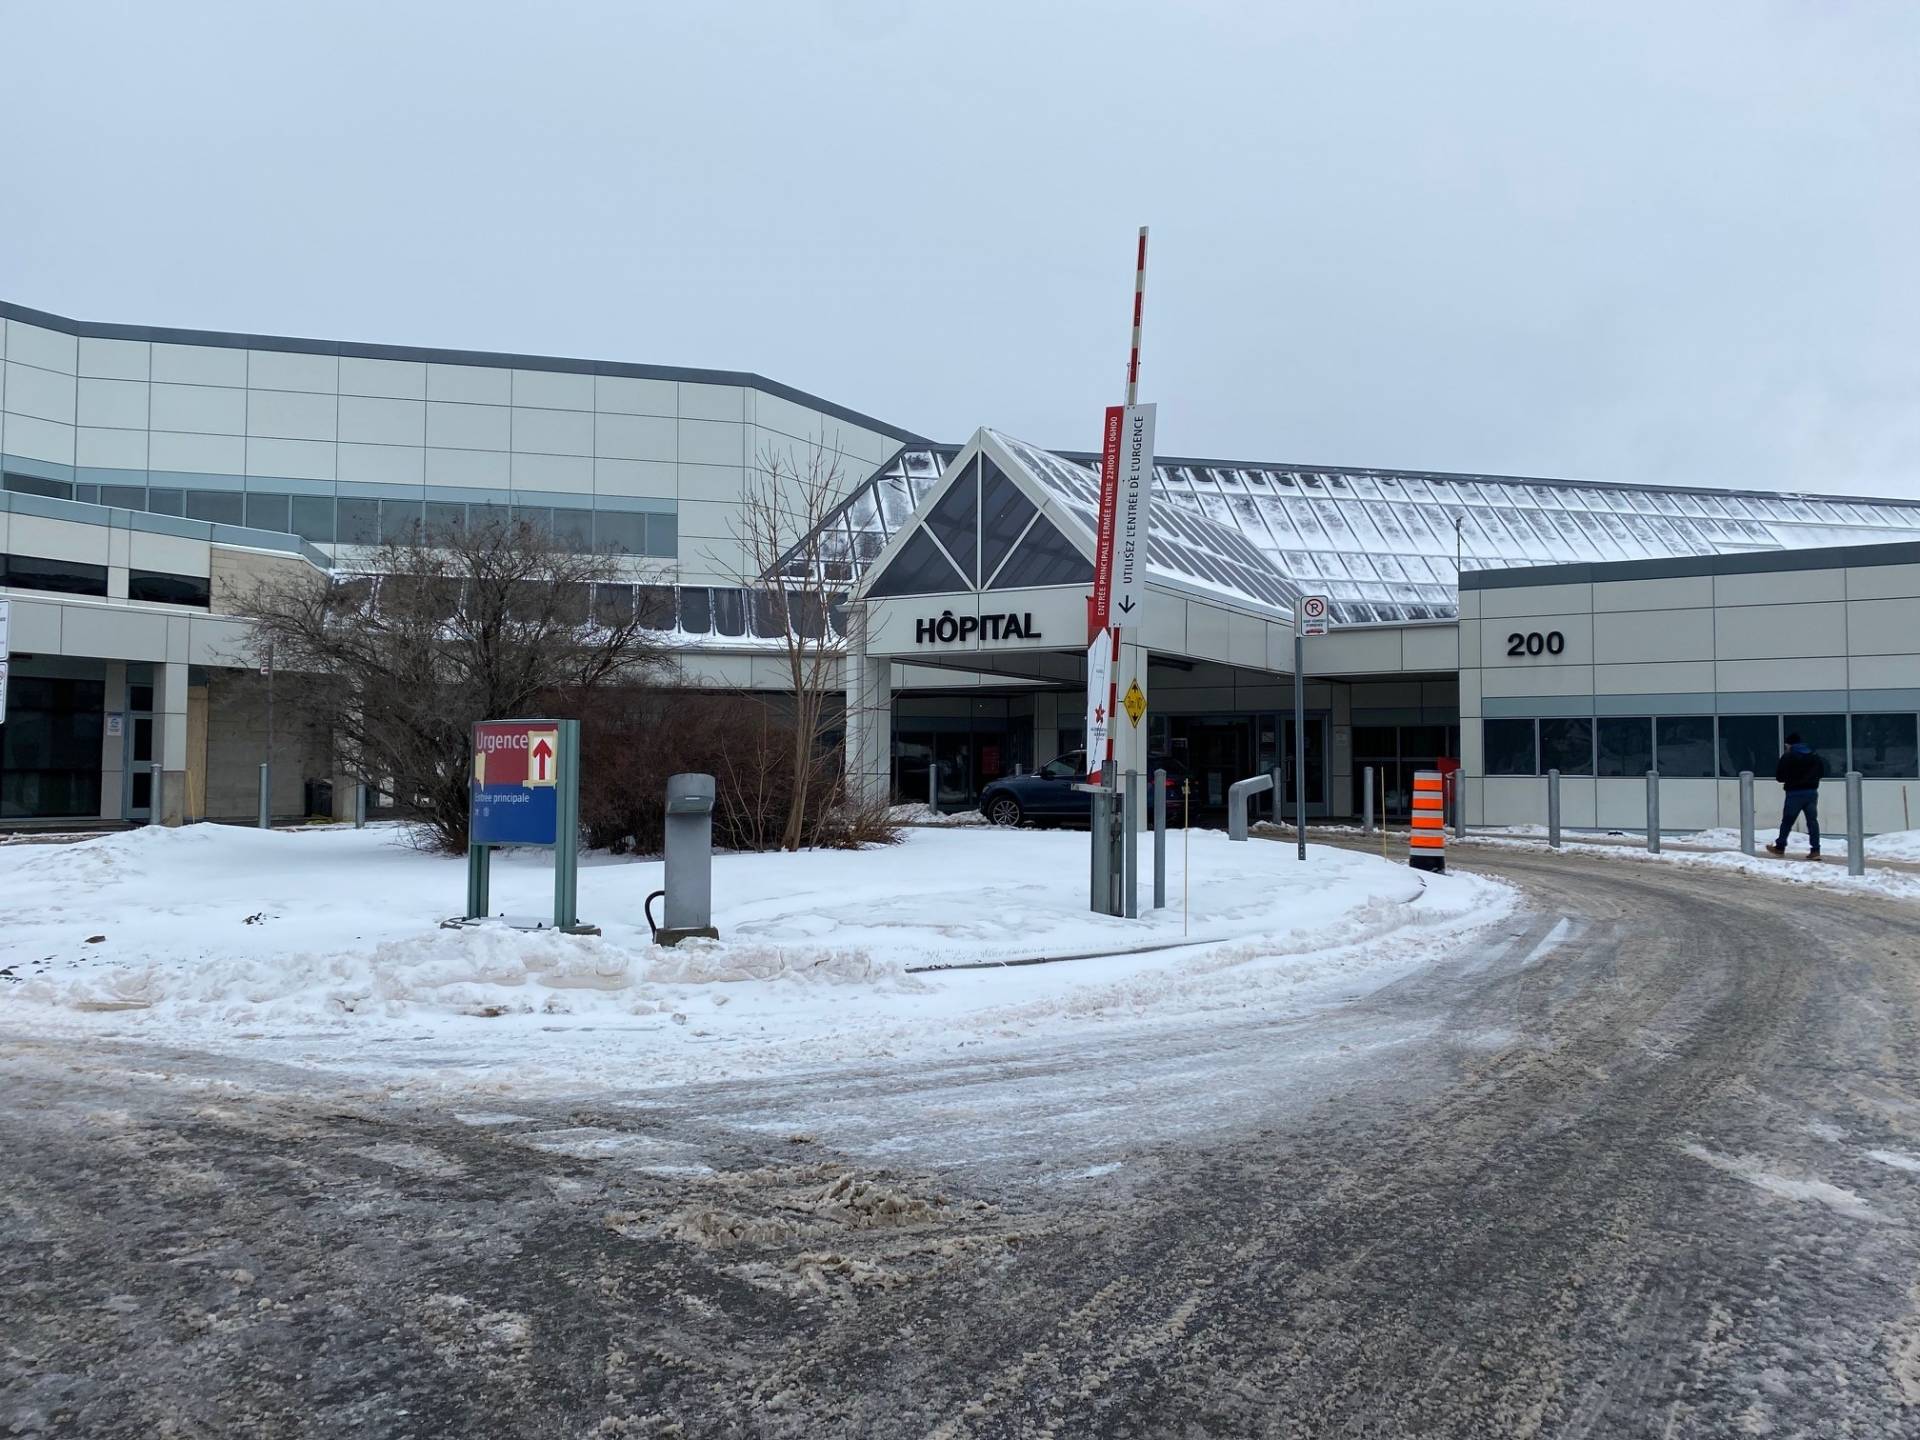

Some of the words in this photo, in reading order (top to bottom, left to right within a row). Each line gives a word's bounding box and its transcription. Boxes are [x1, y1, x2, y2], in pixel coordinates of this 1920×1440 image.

[1109, 416, 1118, 442] 06H00
[1109, 444, 1116, 453] ET
[1132, 415, 1144, 471] L'URGENCE
[1106, 455, 1115, 480] 22H00
[1105, 482, 1113, 506] ENTRE
[1130, 475, 1140, 488] DE
[1102, 508, 1112, 538] FERMÉE
[1127, 491, 1138, 537] L'ENTRÉE
[1100, 541, 1110, 584] PRINCIPALE
[1123, 540, 1135, 584] UTILISEZ
[1098, 588, 1106, 616] ENTRÉE
[915, 610, 1042, 643] HÔPITAL
[1507, 631, 1565, 656] 200
[476, 731, 528, 753] Urgence
[493, 793, 530, 804] principale
